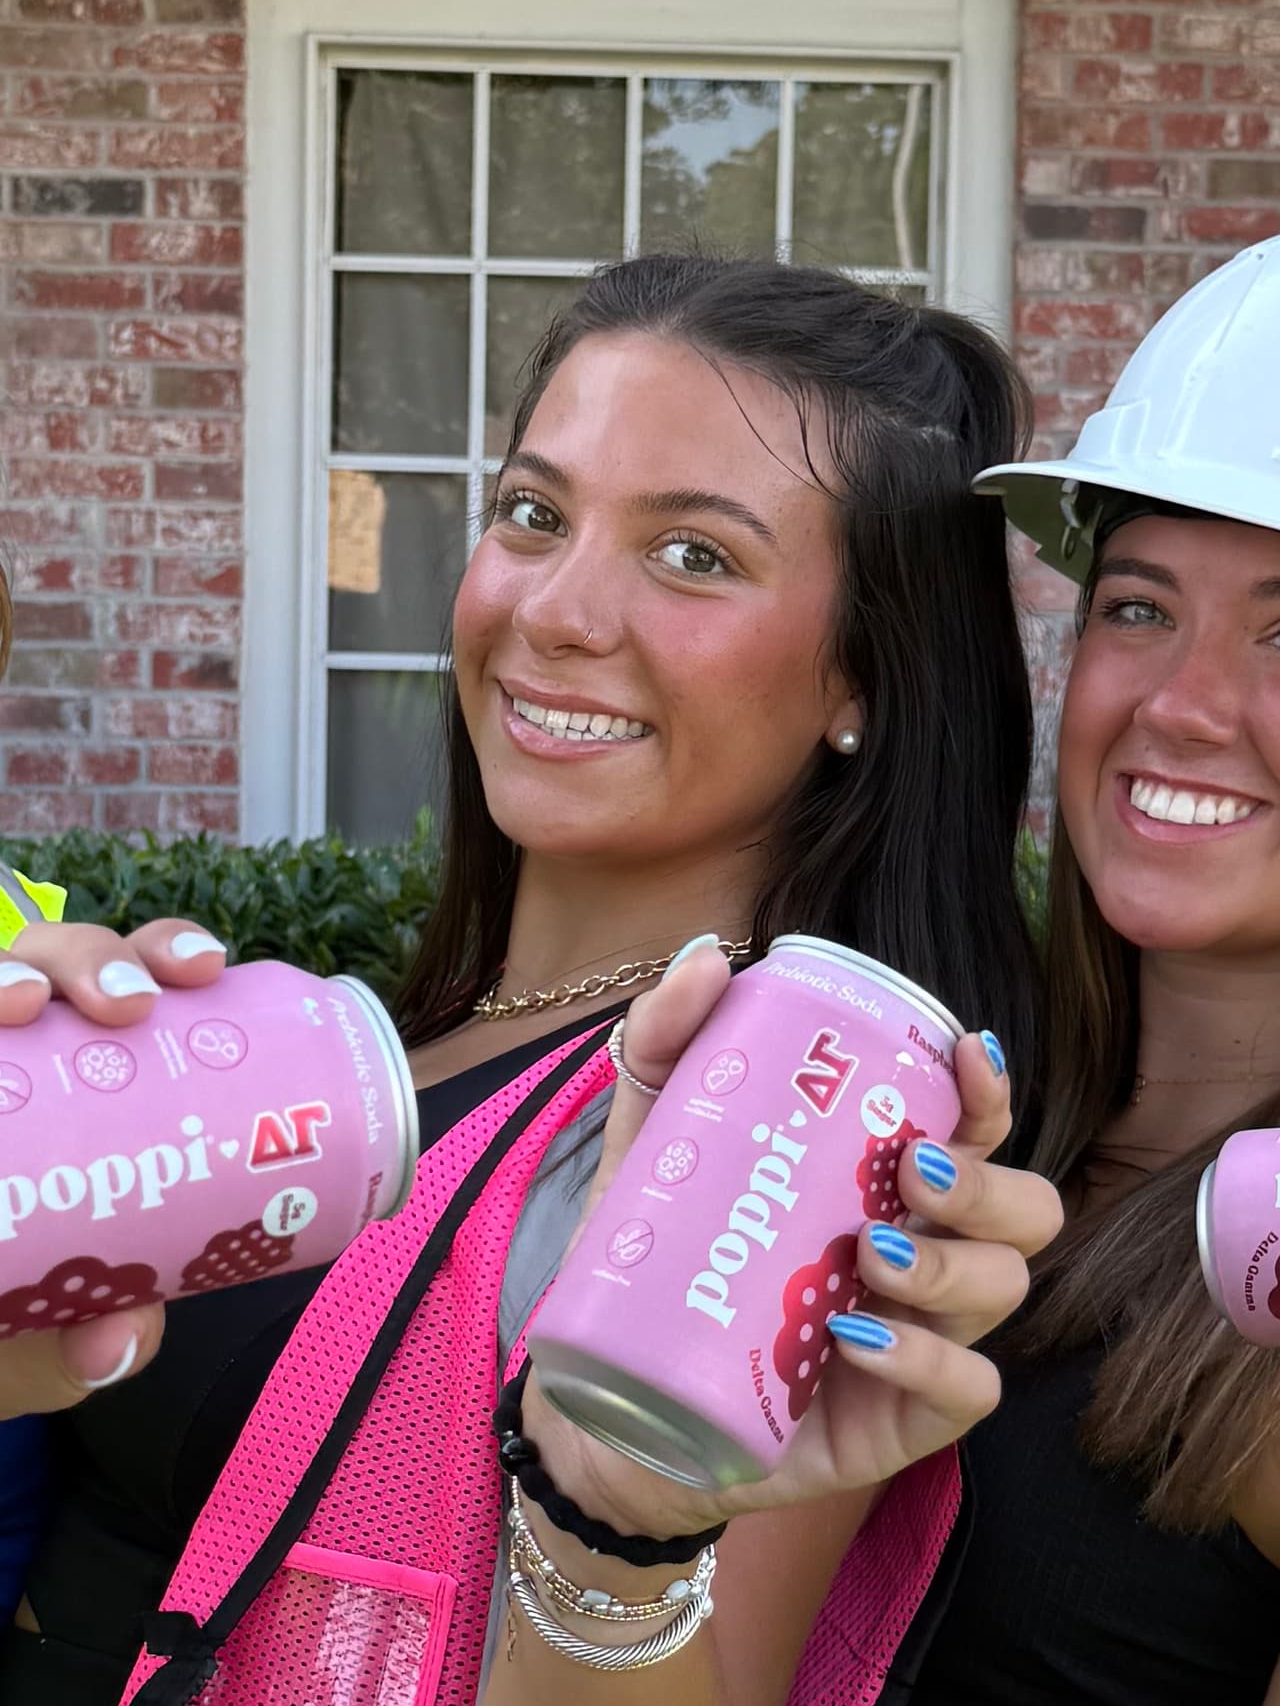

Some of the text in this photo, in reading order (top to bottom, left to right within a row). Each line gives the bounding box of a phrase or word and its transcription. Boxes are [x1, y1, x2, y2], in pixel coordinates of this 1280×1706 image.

[763, 961, 884, 1020] Prebiotic Soda
[362, 1086, 383, 1145] Soda
[686, 1124, 808, 1329] poppi
[1252, 1231, 1279, 1261] Delta
